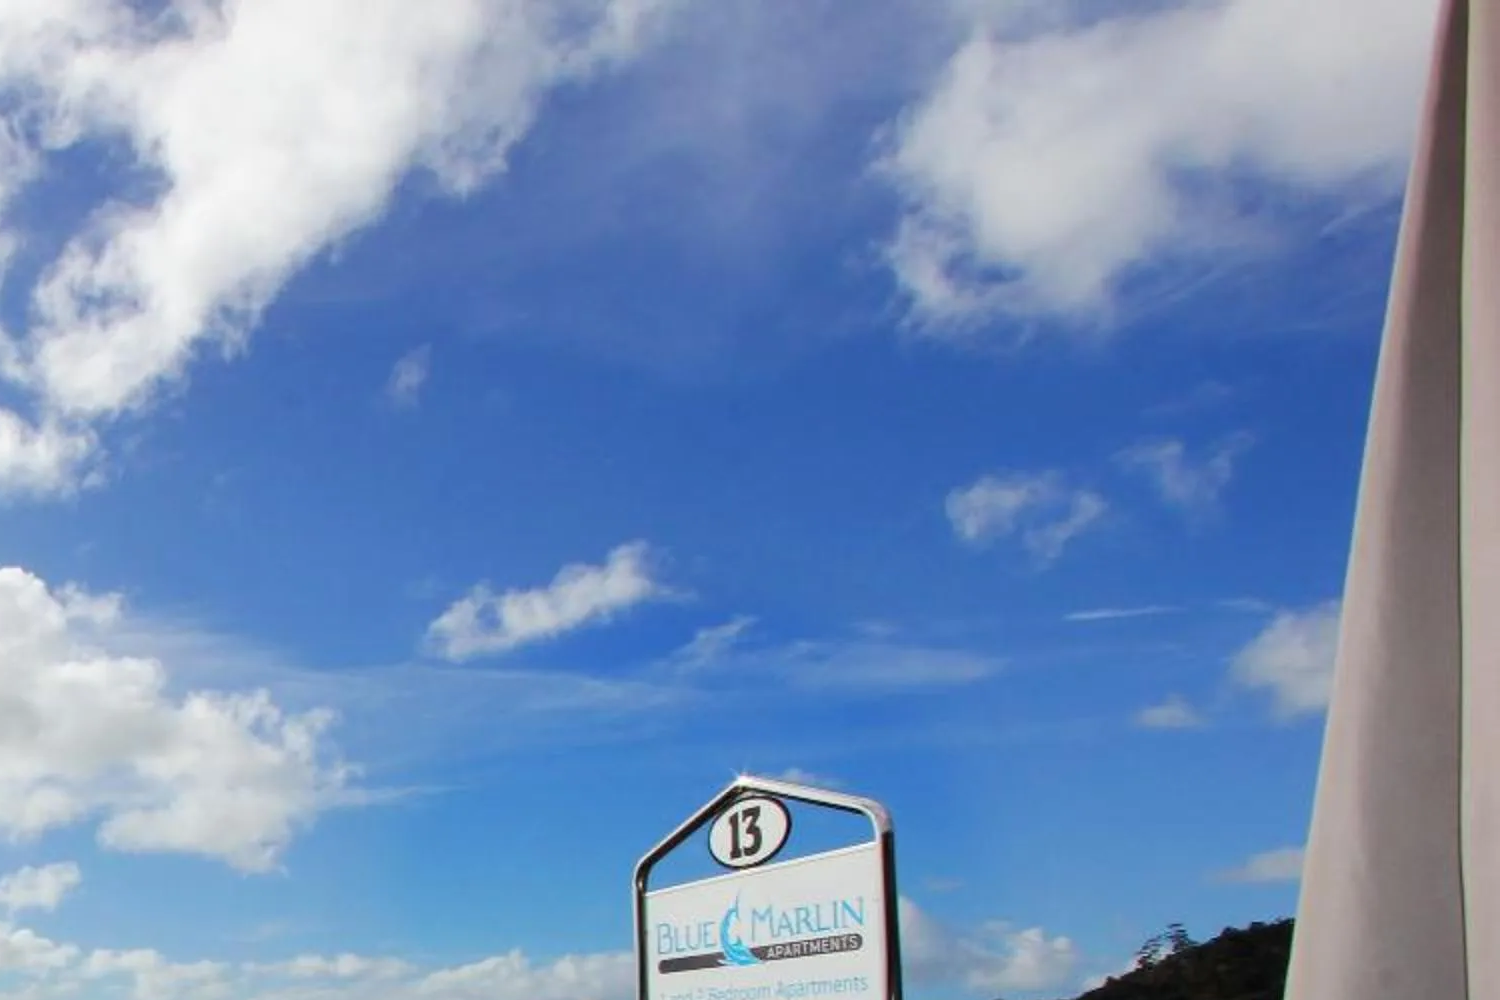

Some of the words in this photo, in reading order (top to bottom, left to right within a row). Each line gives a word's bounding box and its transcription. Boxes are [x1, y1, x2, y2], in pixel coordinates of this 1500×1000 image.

[727, 805, 762, 859] 13
[657, 922, 717, 955] BLUE
[751, 896, 864, 942] MARLIN
[766, 935, 858, 958] APARTMENTS
[776, 976, 869, 1000] Apartments
